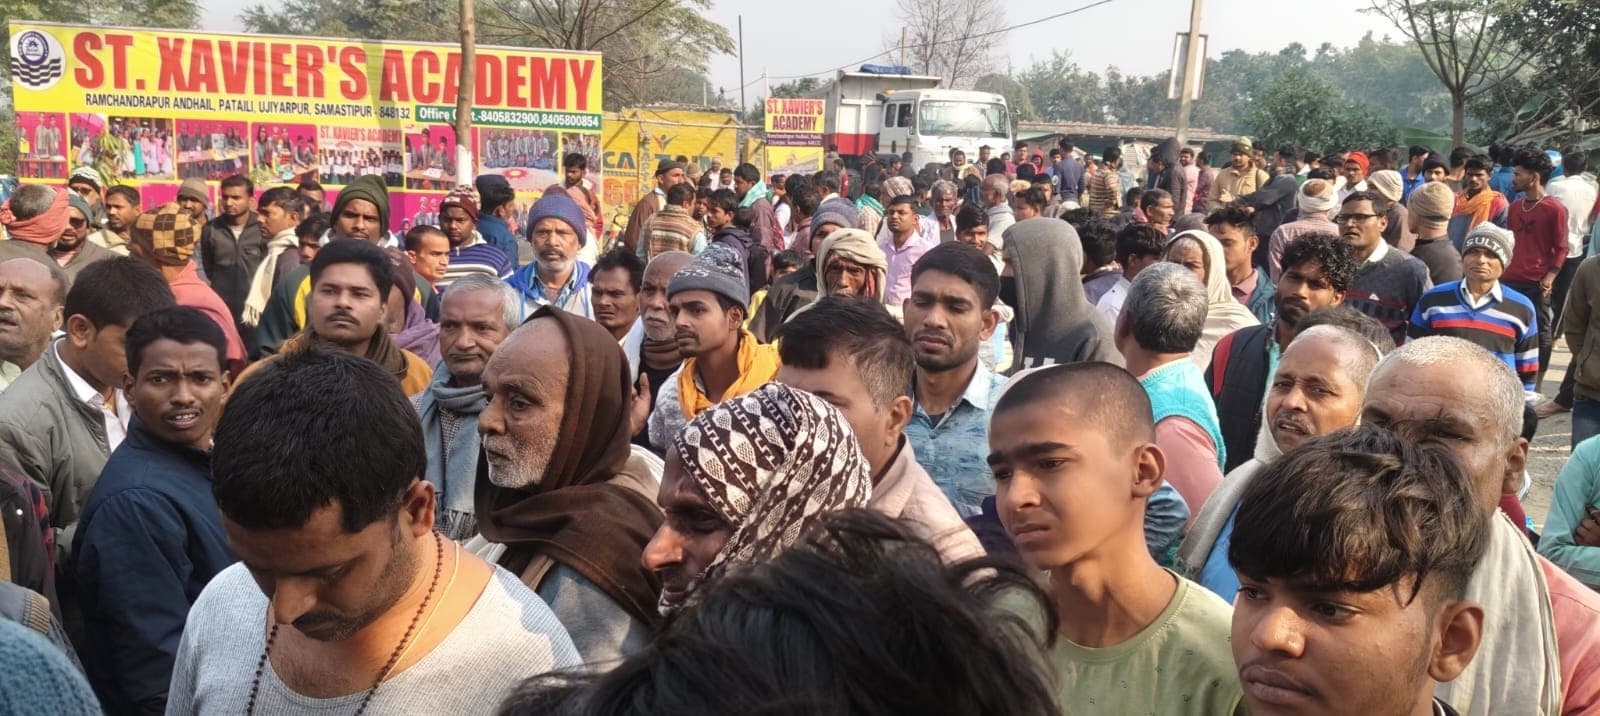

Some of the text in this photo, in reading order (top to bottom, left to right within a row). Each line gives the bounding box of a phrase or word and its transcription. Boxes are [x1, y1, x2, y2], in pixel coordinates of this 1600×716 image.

[74, 32, 146, 90] ST.
[157, 37, 368, 101] XAVIER'S
[86, 93, 170, 108] RAMCHANDRAPUR
[173, 97, 216, 112] ANDHAIL,
[259, 101, 312, 117] UJIYARPUR,
[315, 103, 372, 117] SAMASTIPUR
[380, 106, 410, 119] 848132
[420, 107, 449, 120] Office
[782, 100, 823, 115] XAVIER'S
[773, 115, 817, 131] ACADEMY
